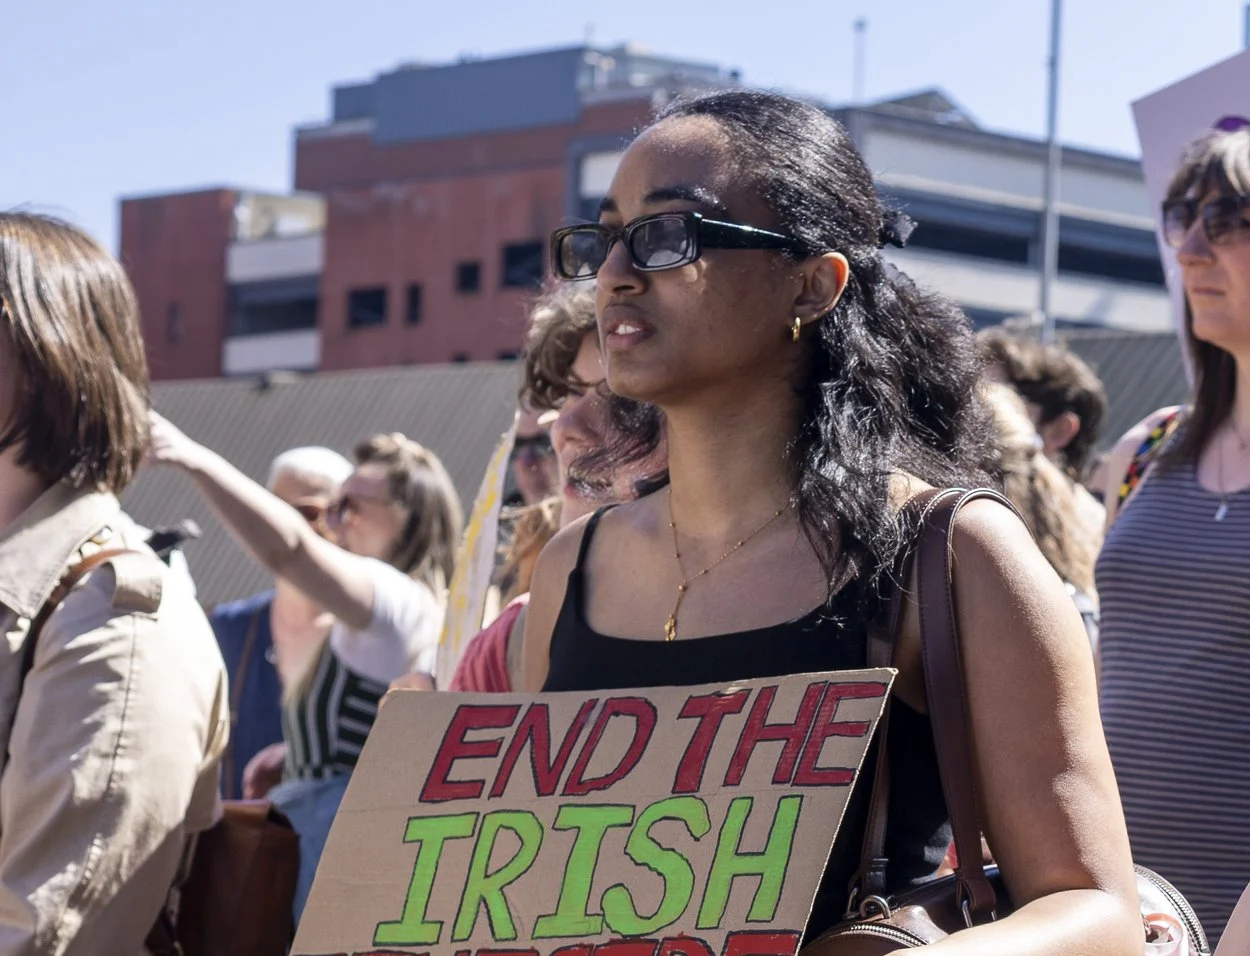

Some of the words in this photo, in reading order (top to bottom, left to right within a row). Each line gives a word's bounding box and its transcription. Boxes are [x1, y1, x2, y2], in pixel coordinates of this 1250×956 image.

[419, 696, 657, 803] END
[671, 681, 889, 794] THE
[373, 796, 803, 946] IRISH
